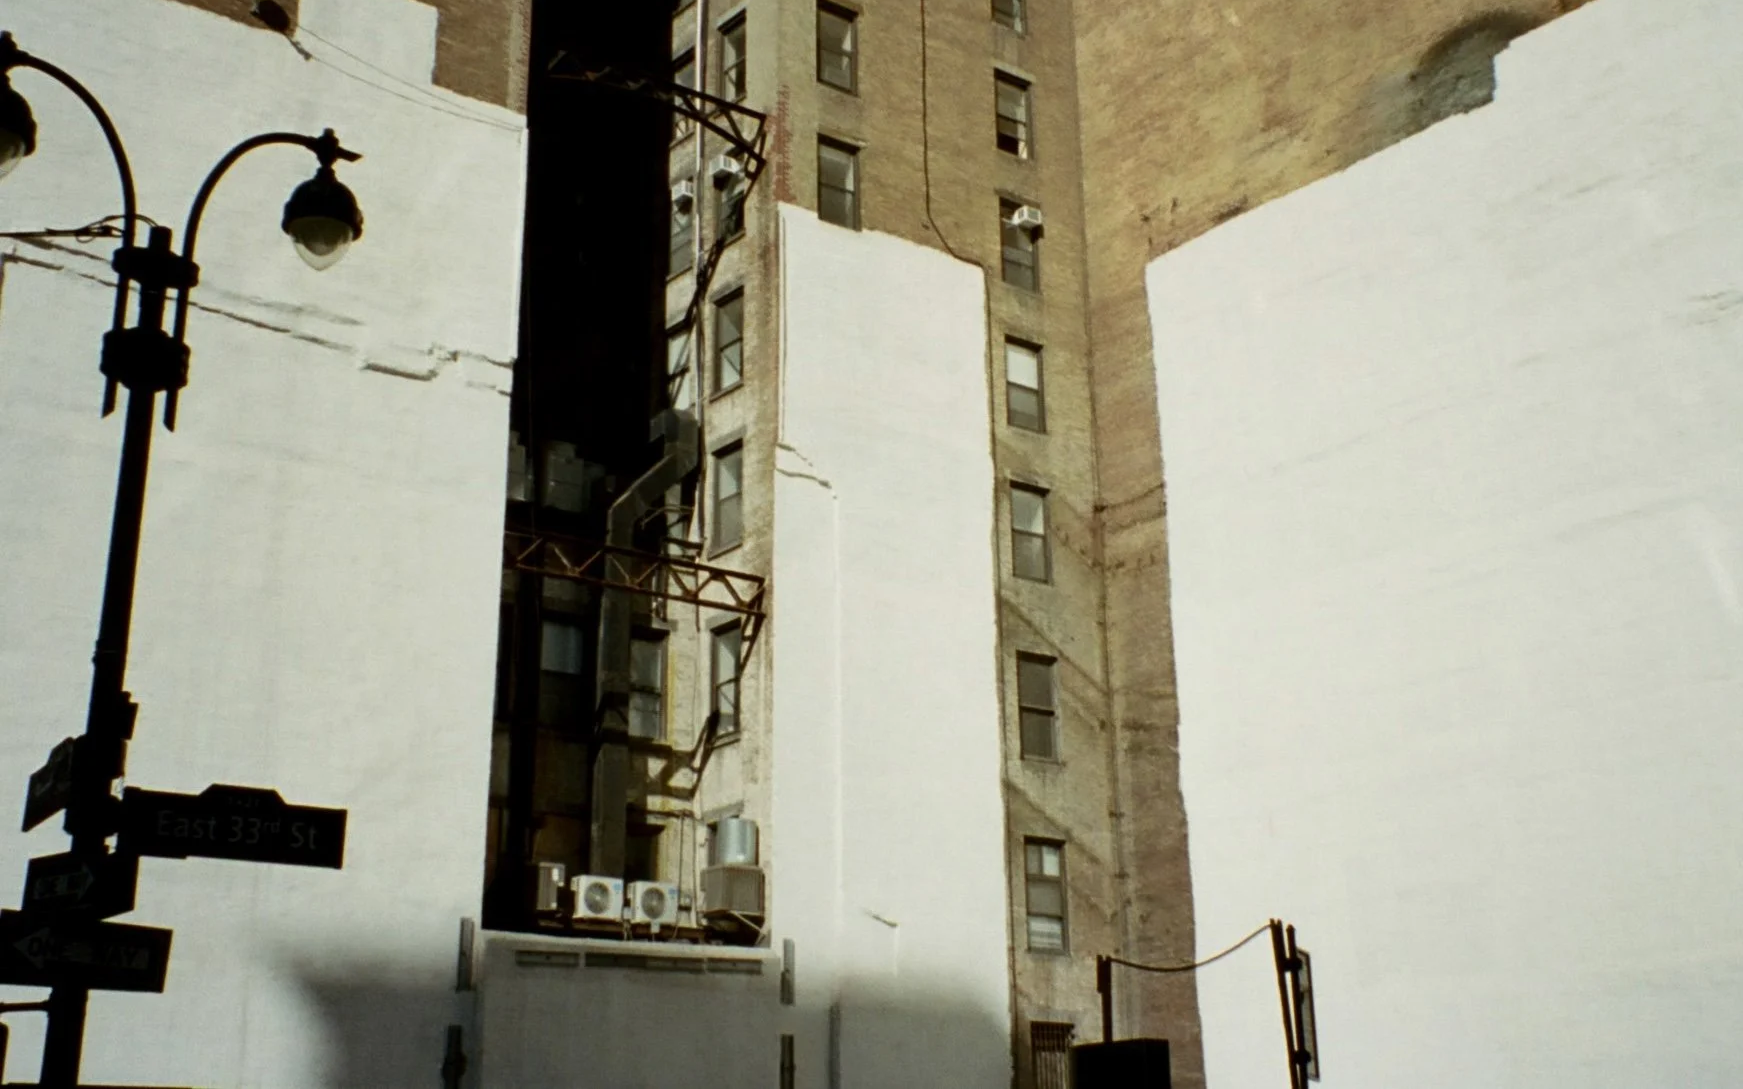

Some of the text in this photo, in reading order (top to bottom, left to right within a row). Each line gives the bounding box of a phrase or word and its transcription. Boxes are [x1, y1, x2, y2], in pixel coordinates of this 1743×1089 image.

[156, 808, 317, 850] East 33rd St
